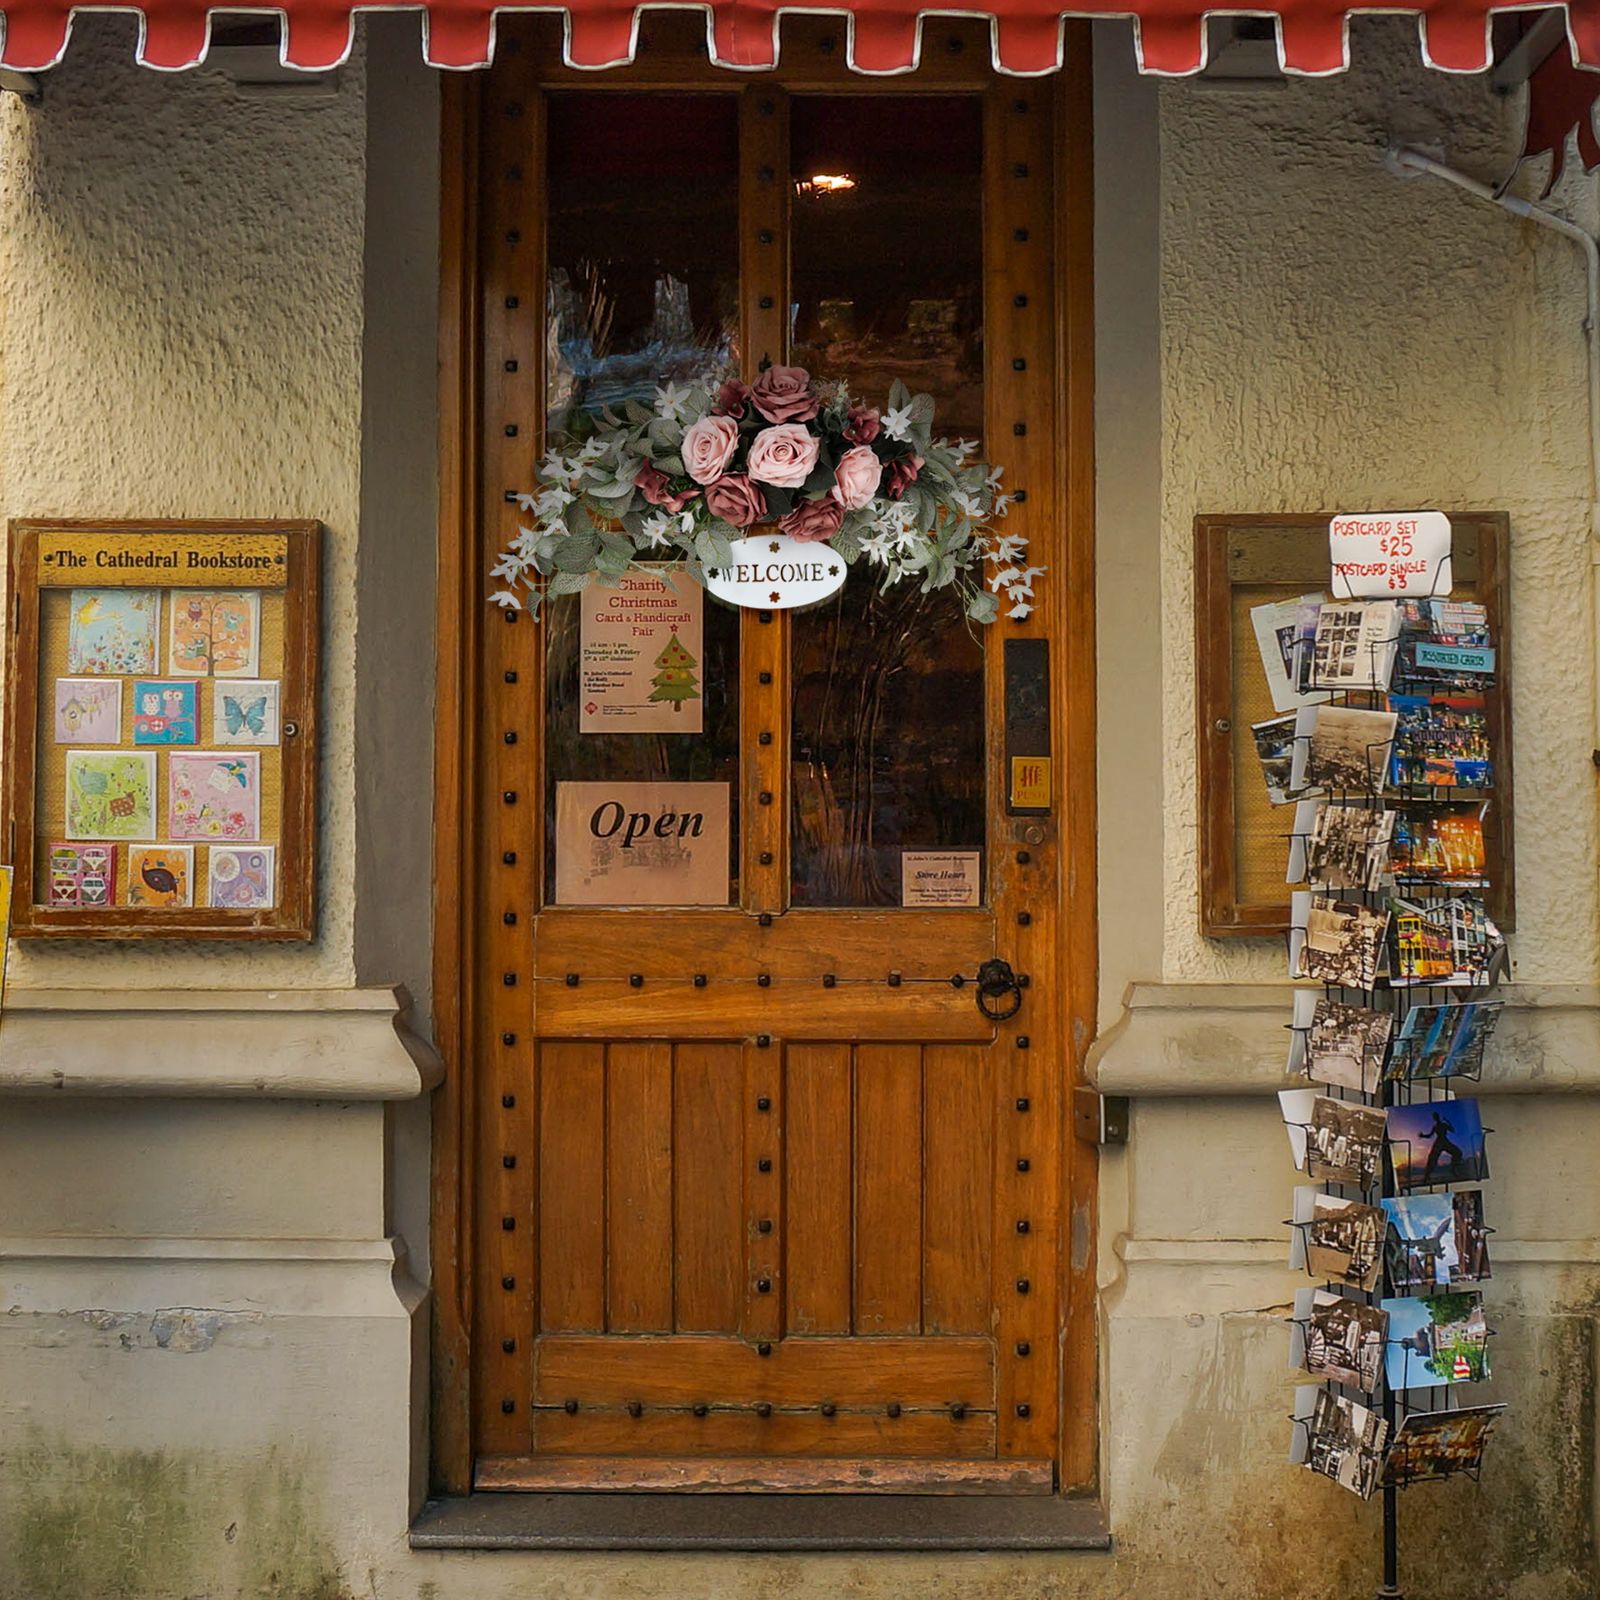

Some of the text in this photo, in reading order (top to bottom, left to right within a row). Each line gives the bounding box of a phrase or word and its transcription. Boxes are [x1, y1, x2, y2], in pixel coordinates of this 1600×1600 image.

[1333, 520, 1418, 536] POSTCARD SET
[1380, 536, 1413, 557] $25
[56, 551, 272, 568] The Cathedral Bookstore
[722, 563, 825, 583] WELCOME
[1334, 563, 1388, 576] POSTCARD
[1388, 574, 1408, 590] $3
[608, 596, 678, 608] Christmas
[595, 613, 624, 622] Card
[633, 612, 692, 622] Handicraft
[632, 627, 655, 636] Fair
[590, 801, 704, 848] Open
